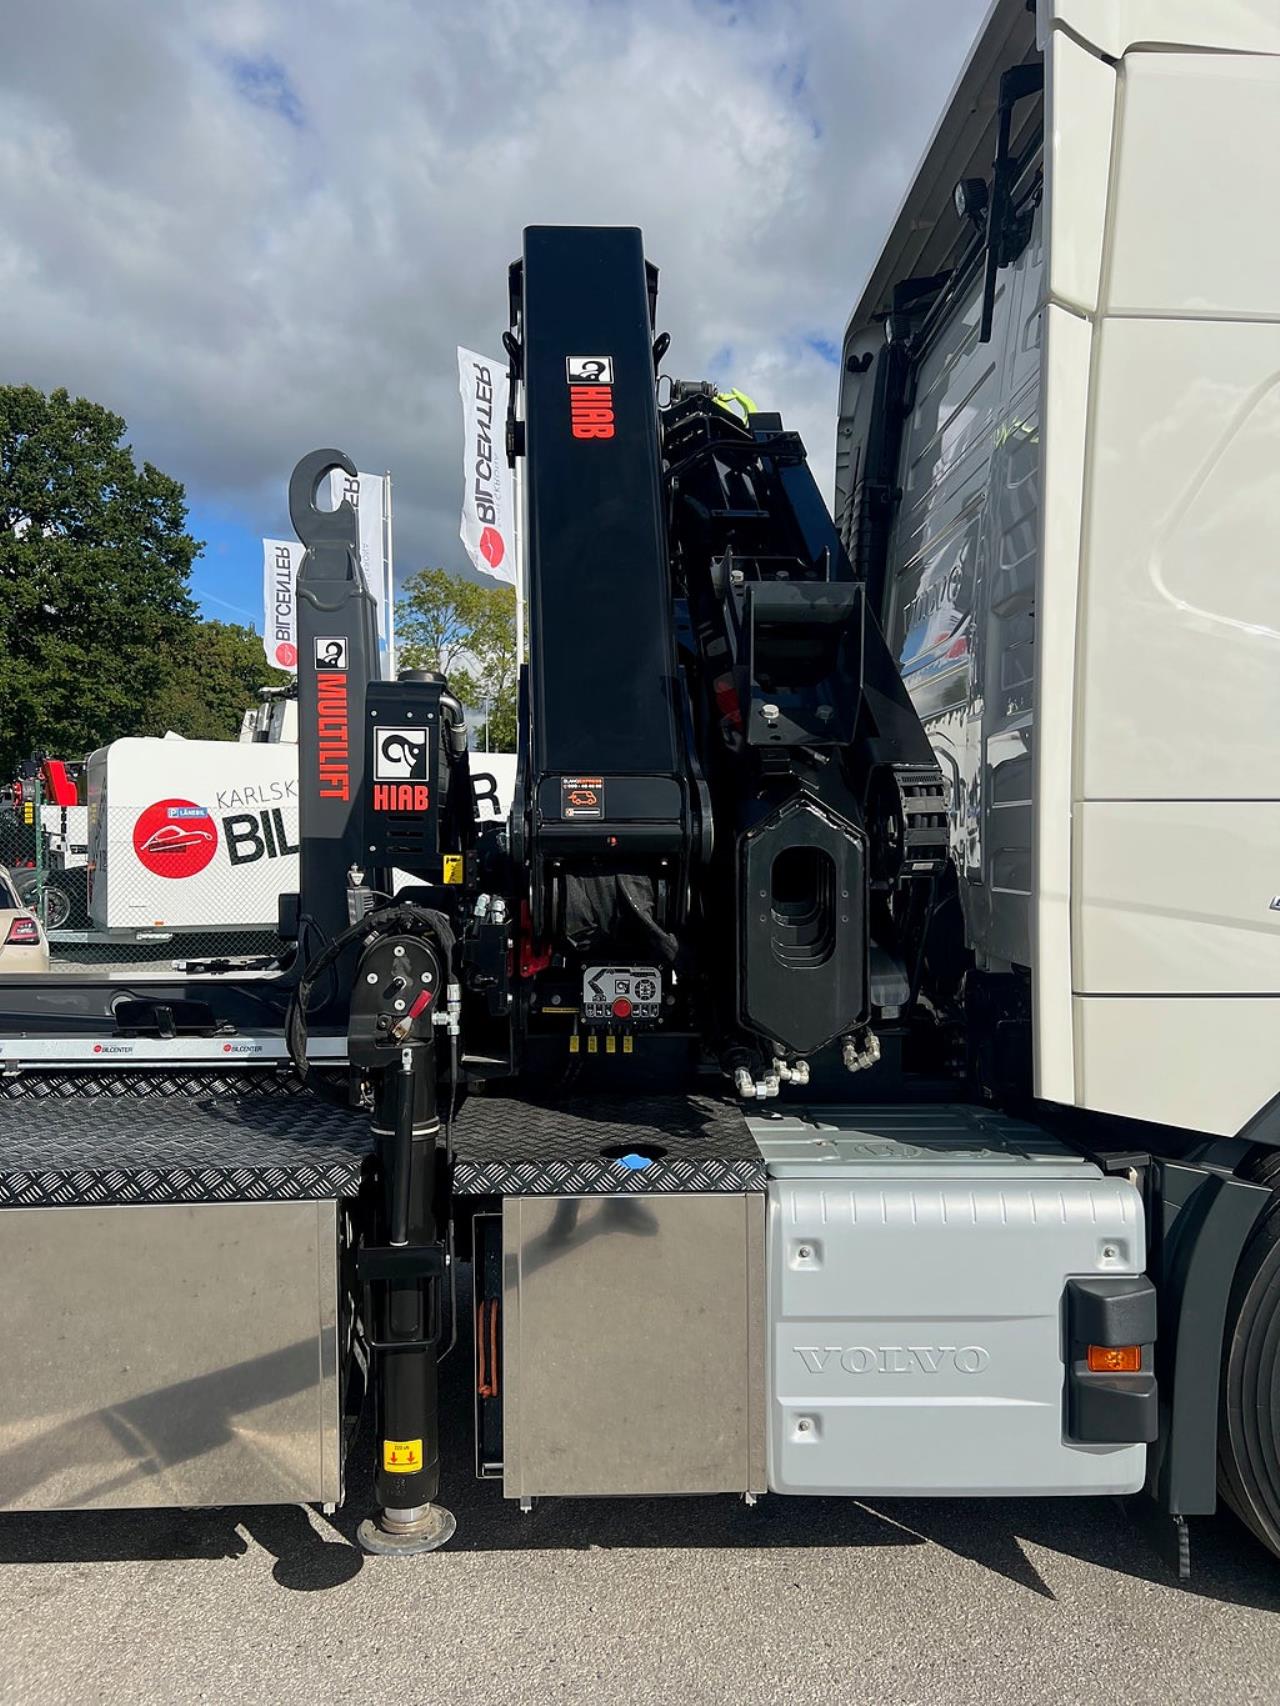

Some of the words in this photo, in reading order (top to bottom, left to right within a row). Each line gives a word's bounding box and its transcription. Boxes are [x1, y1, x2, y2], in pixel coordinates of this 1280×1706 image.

[570, 386, 615, 439] HIAB
[316, 673, 351, 801] MULTILIFT
[216, 780, 300, 809] KARLSK
[374, 784, 430, 812] HIAB
[231, 1045, 263, 1053] BILCENTER
[793, 1346, 990, 1375] VOLVO
